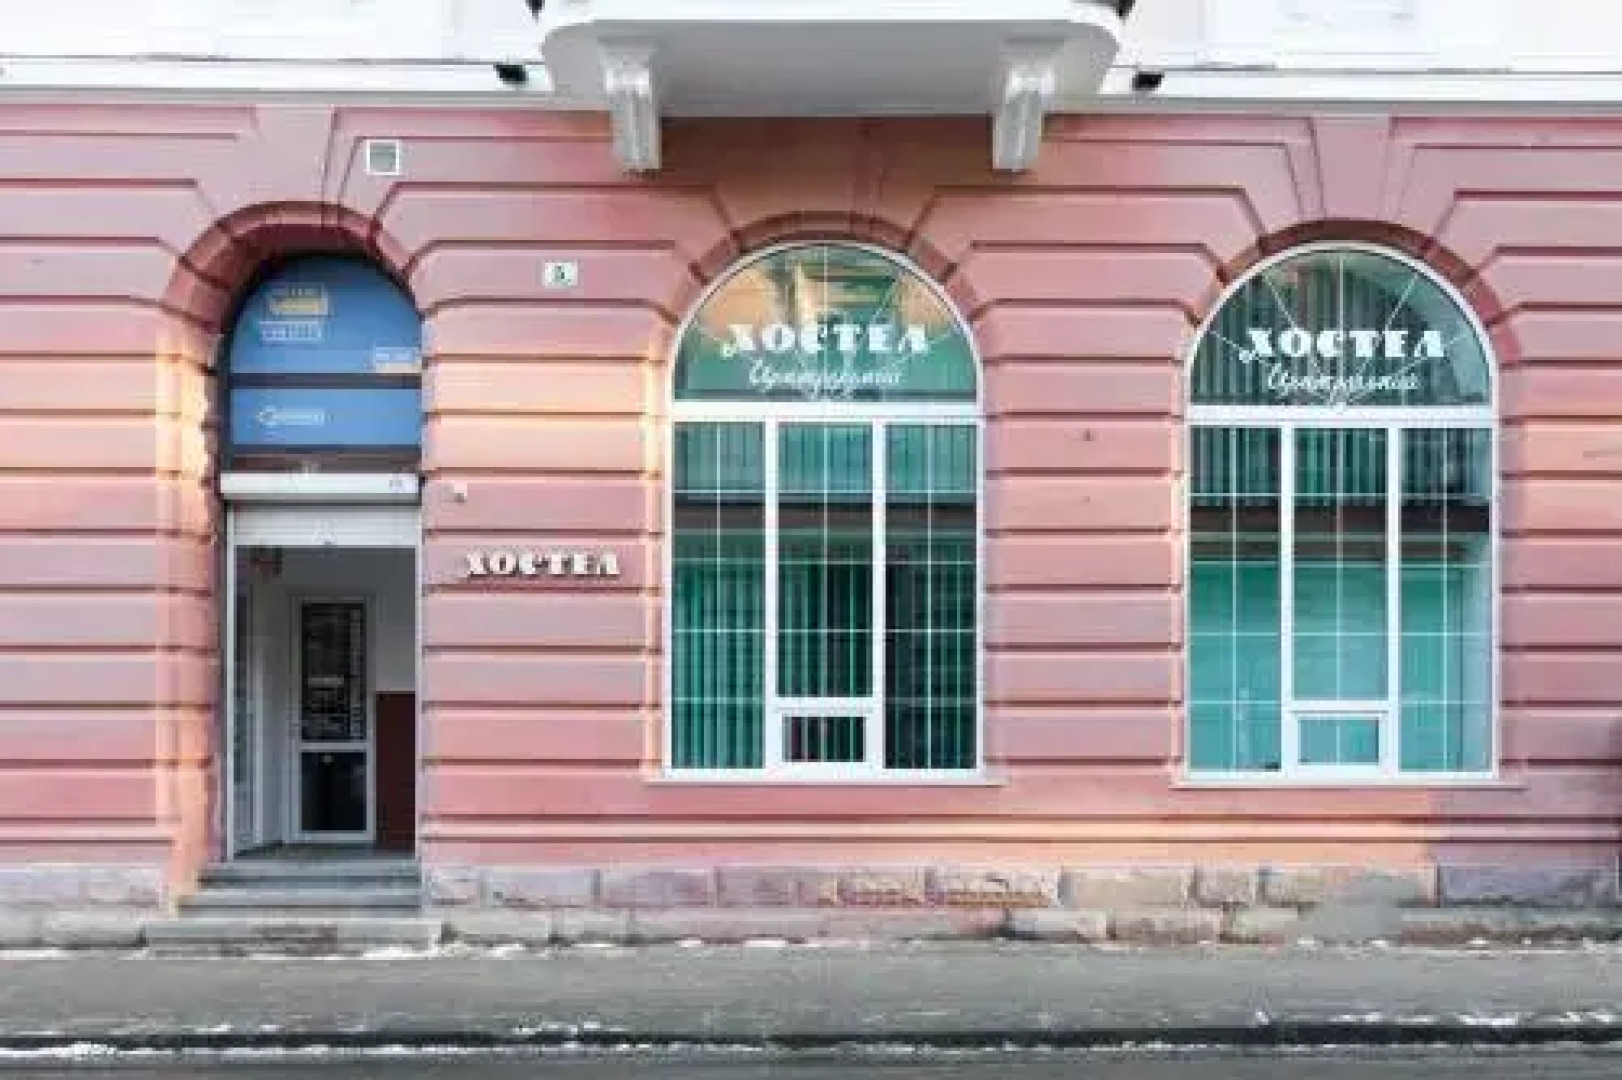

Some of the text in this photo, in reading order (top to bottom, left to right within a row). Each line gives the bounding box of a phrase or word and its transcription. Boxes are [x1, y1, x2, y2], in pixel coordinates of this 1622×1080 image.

[721, 323, 929, 358] ХОСТЕЛ
[1238, 329, 1445, 364] ХОСТЕЛ
[460, 551, 621, 577] ХОСТЕЛ
